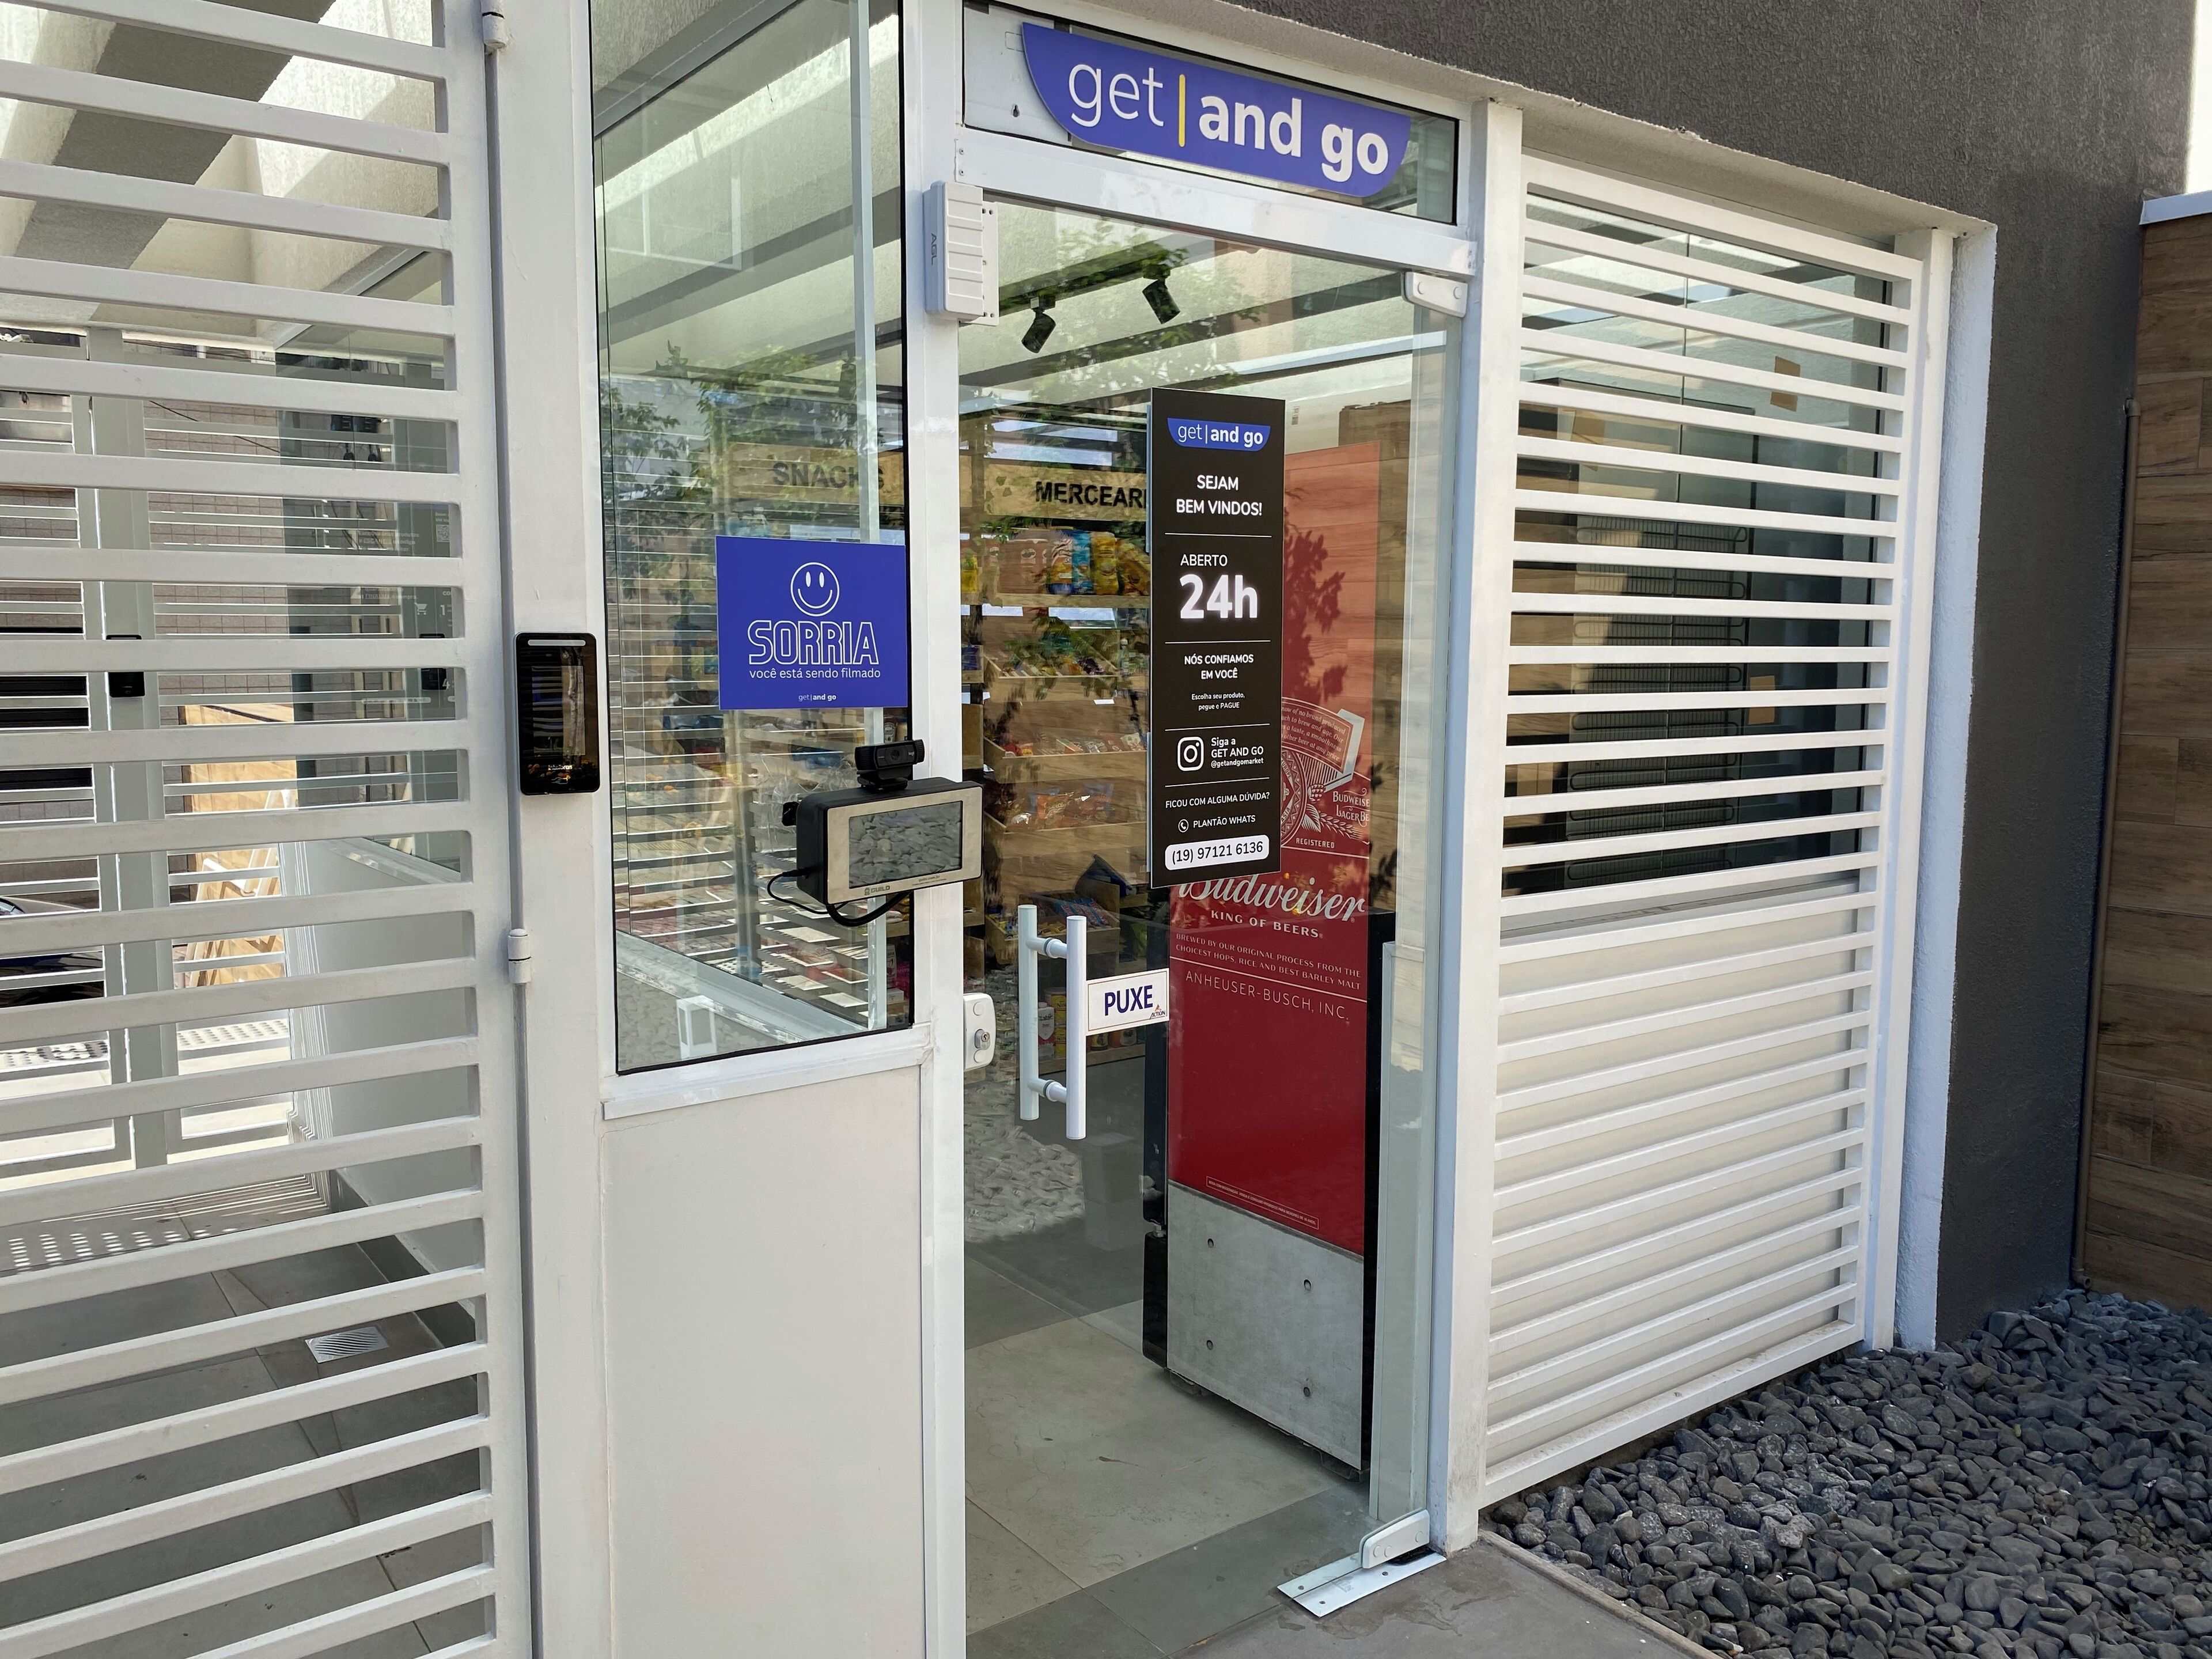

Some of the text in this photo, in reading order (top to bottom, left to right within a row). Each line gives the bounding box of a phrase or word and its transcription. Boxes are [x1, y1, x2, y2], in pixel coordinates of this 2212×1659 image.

[1069, 64, 1389, 182] get and go
[1178, 424, 1263, 448] get and go
[1197, 475, 1238, 490] SEJAM
[1036, 481, 1146, 509] MERCEARI
[1176, 499, 1262, 516] BEM VINDOS!
[1180, 554, 1228, 566] ABERTO
[1180, 574, 1257, 619] 24h
[748, 620, 880, 665] SORRIA
[1184, 654, 1254, 665] NÓS CONFIAMOS
[749, 668, 881, 679] você está sendo filmado
[1201, 668, 1238, 679] EM VOCÊ
[1298, 718, 1310, 727] brew
[1334, 733, 1344, 743] Our
[1306, 713, 1322, 722] brand
[1322, 719, 1346, 734] produced
[1211, 737, 1229, 747] Siga
[1284, 733, 1297, 741] other
[1298, 737, 1309, 745] beer
[1316, 745, 1325, 754] any
[1311, 733, 1342, 752] smoothness
[1211, 746, 1263, 758] GET AND GO
[1211, 758, 1263, 768] @getandgomarket
[1165, 791, 1270, 808] FICOU COM ALGUMA DÚVIDA?
[1193, 816, 1255, 828] PLANTÃO WHATS
[1172, 841, 1263, 865] (19) 97121 6136
[1296, 838, 1335, 849] REGISTERED
[1211, 910, 1243, 923] KING
[1249, 917, 1267, 927] OF
[1176, 933, 1206, 945] BREWED
[1219, 942, 1234, 950] OUR
[1237, 945, 1274, 960] ORIGINAL
[1277, 954, 1314, 968] PROCESS
[1317, 962, 1342, 974] FROM
[1344, 968, 1361, 978] THE
[1176, 944, 1211, 957] CHOICEST
[1238, 958, 1256, 967] RICE
[1259, 962, 1276, 972] AND
[1278, 966, 1299, 976] BEST
[1302, 971, 1335, 984] BARLEY
[1338, 979, 1361, 990] MALT
[1104, 984, 1153, 1016] PUXE
[1185, 970, 1349, 1020] ANHEUSER-BUSCH, INC.
